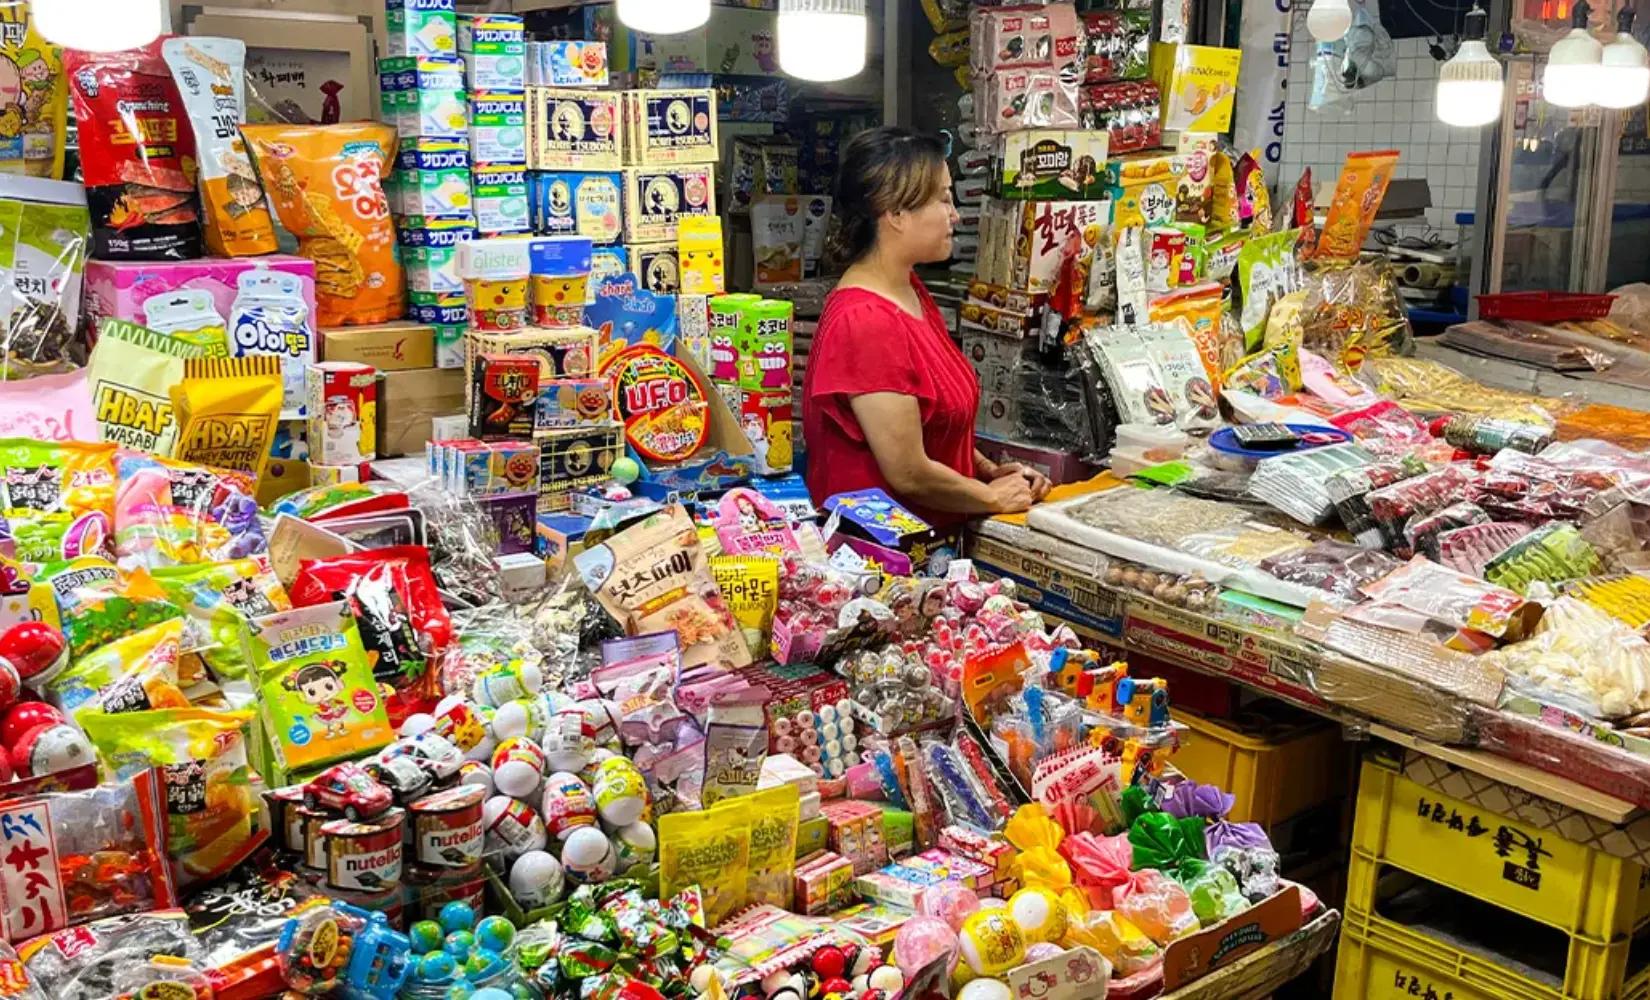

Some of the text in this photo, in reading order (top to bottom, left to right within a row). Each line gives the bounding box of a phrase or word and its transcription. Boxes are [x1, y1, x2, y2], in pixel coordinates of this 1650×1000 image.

[473, 252, 522, 271] glister
[97, 386, 174, 436] HBAF
[103, 423, 158, 449] WASABI
[189, 417, 267, 450] HBAF
[216, 450, 259, 461] BUTTER
[269, 634, 346, 661] 헤드셋드링크
[430, 821, 484, 848] nutella
[345, 848, 402, 872] nutella
